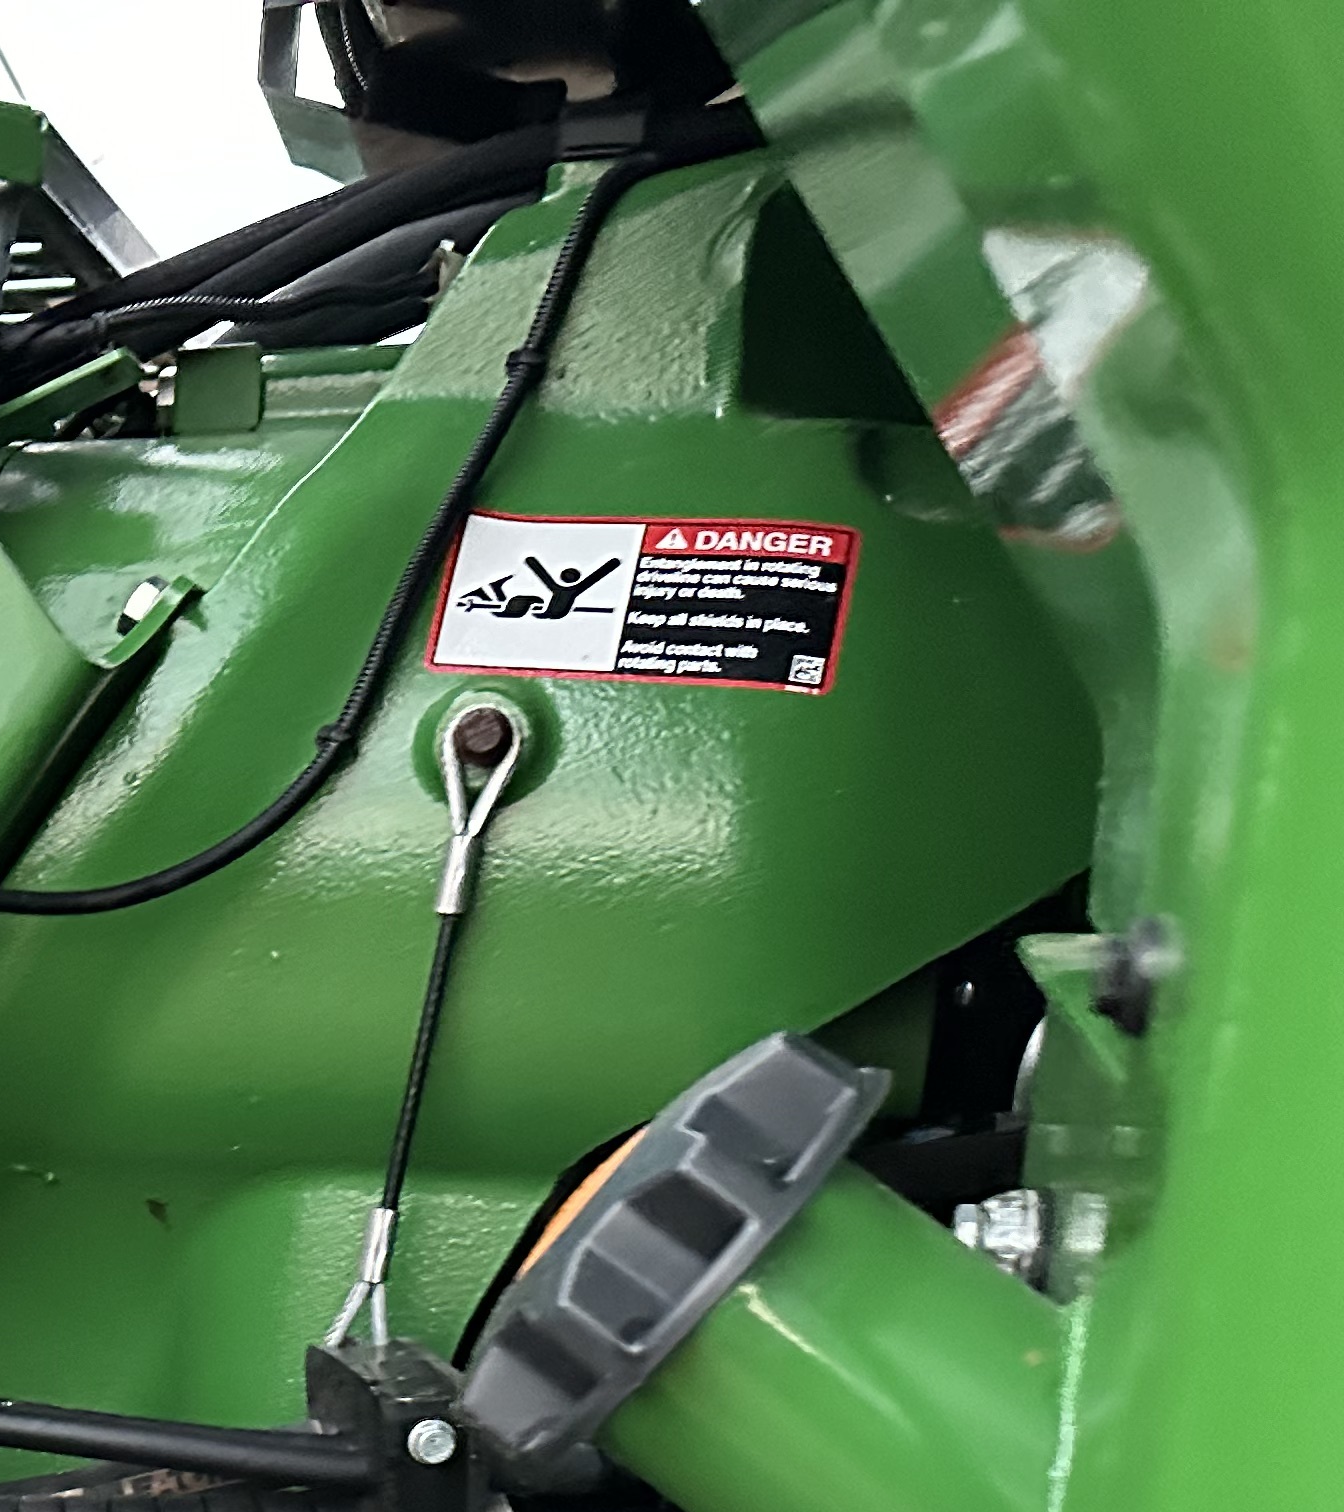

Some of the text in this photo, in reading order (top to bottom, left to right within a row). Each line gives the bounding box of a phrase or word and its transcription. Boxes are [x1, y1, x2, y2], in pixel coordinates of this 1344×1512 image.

[695, 530, 833, 556] DANGER
[639, 557, 821, 579] Entanglement in rotating
[633, 584, 746, 600] injury or death.
[702, 574, 731, 585] can
[732, 574, 779, 587] cause
[780, 577, 838, 592] serious
[626, 611, 810, 633] Keep all shields in place.
[620, 640, 759, 659] Avoid contact with
[617, 656, 723, 674] rotating parts.
